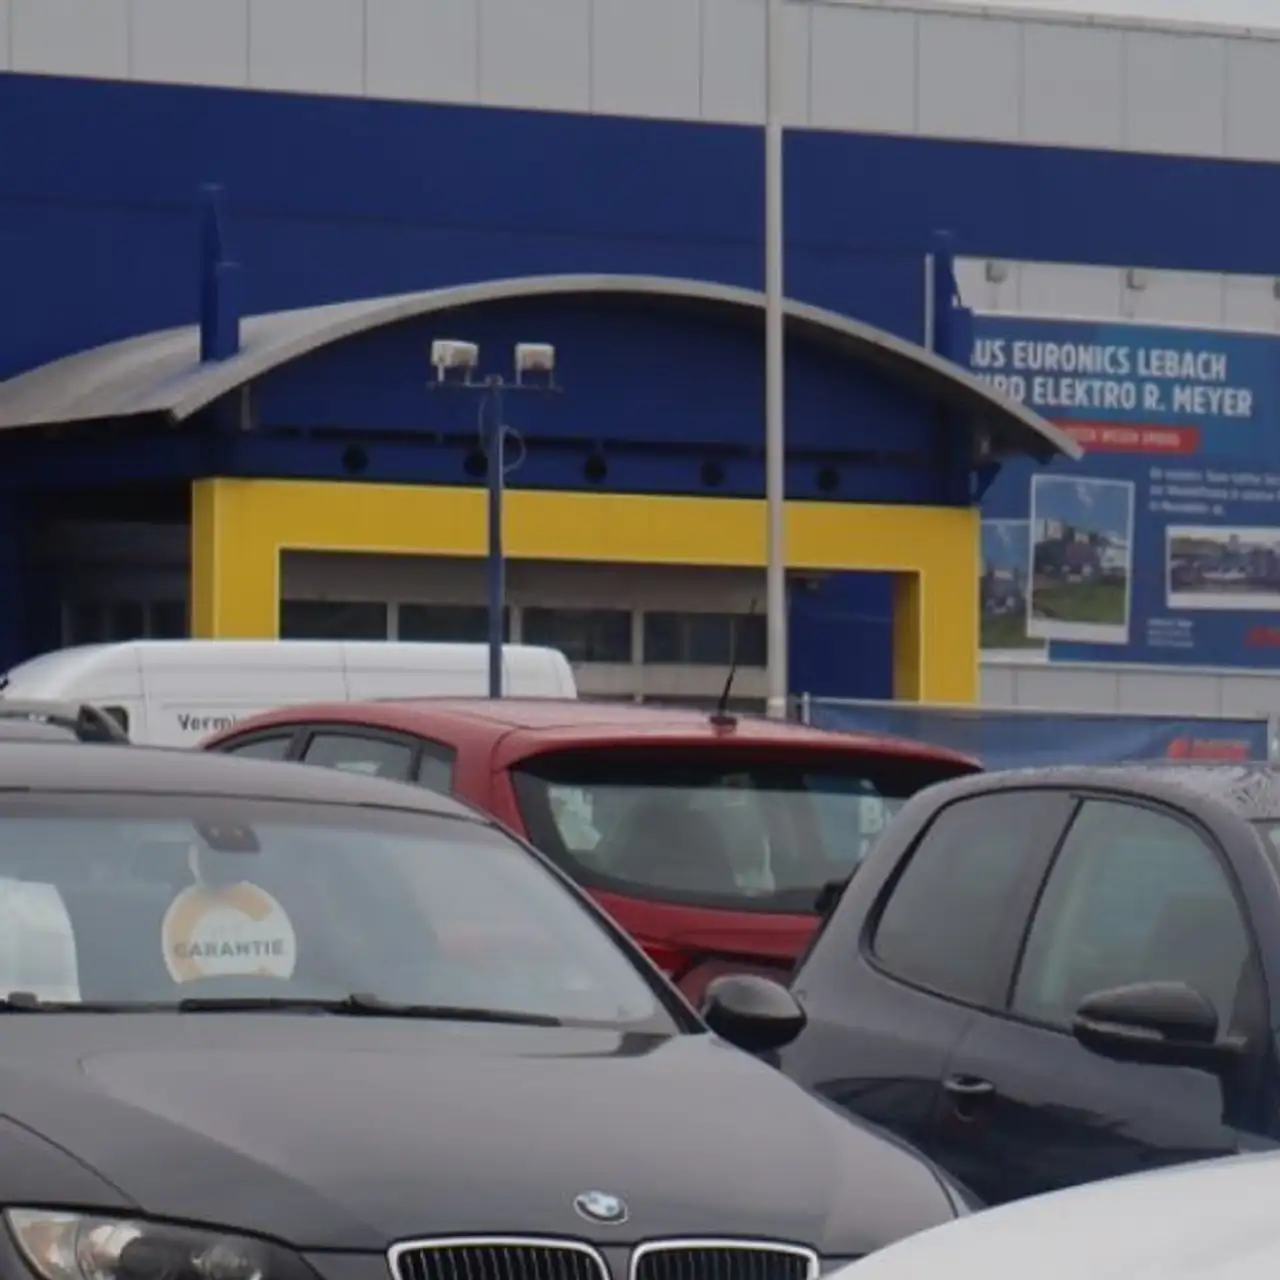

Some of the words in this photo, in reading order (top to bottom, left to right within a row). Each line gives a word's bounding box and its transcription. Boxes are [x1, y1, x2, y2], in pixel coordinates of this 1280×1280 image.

[970, 339, 1006, 369] US
[1012, 341, 1131, 376] EURONICS
[1137, 348, 1227, 382] LEBACH
[1032, 375, 1136, 410] ELEKTRO
[1142, 383, 1167, 412] R.
[1173, 383, 1253, 418] MEYER
